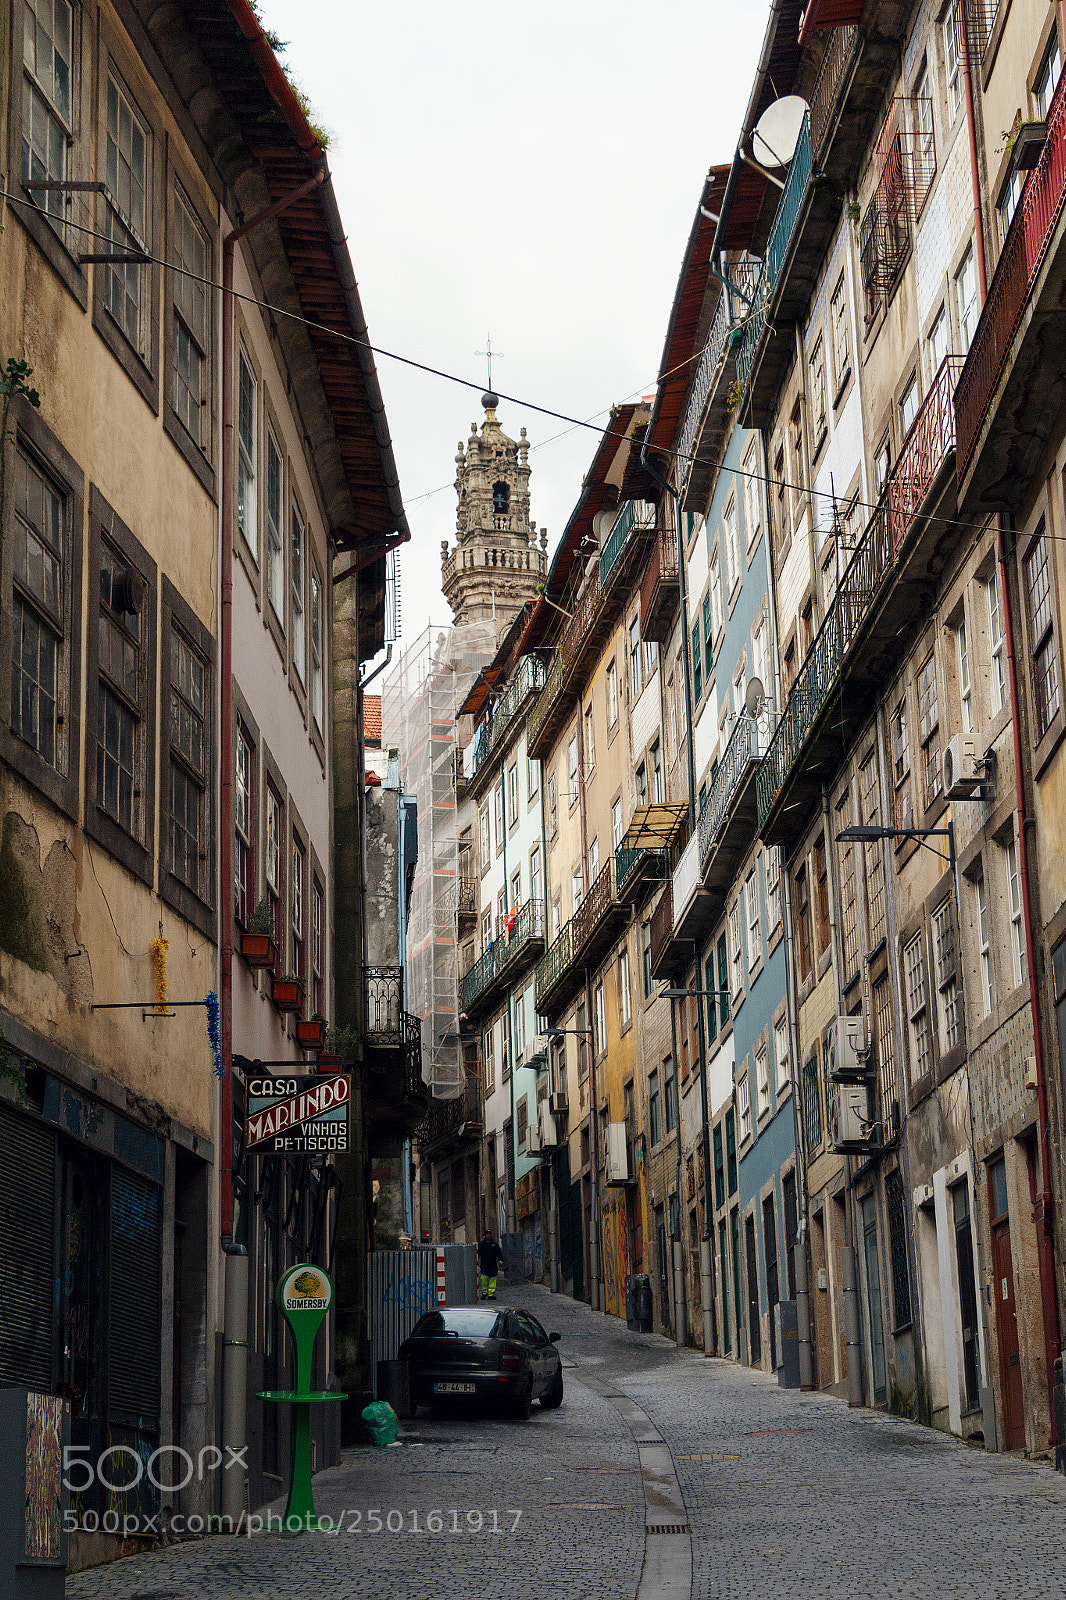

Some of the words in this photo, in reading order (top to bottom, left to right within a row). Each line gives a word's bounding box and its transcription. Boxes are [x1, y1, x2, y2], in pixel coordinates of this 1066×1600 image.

[249, 1079, 298, 1096] CASA
[248, 1078, 348, 1145] MARLINDO
[301, 1122, 347, 1136] VINHOS
[274, 1137, 347, 1151] PETISCOS
[286, 1298, 328, 1309] SOMERSBY
